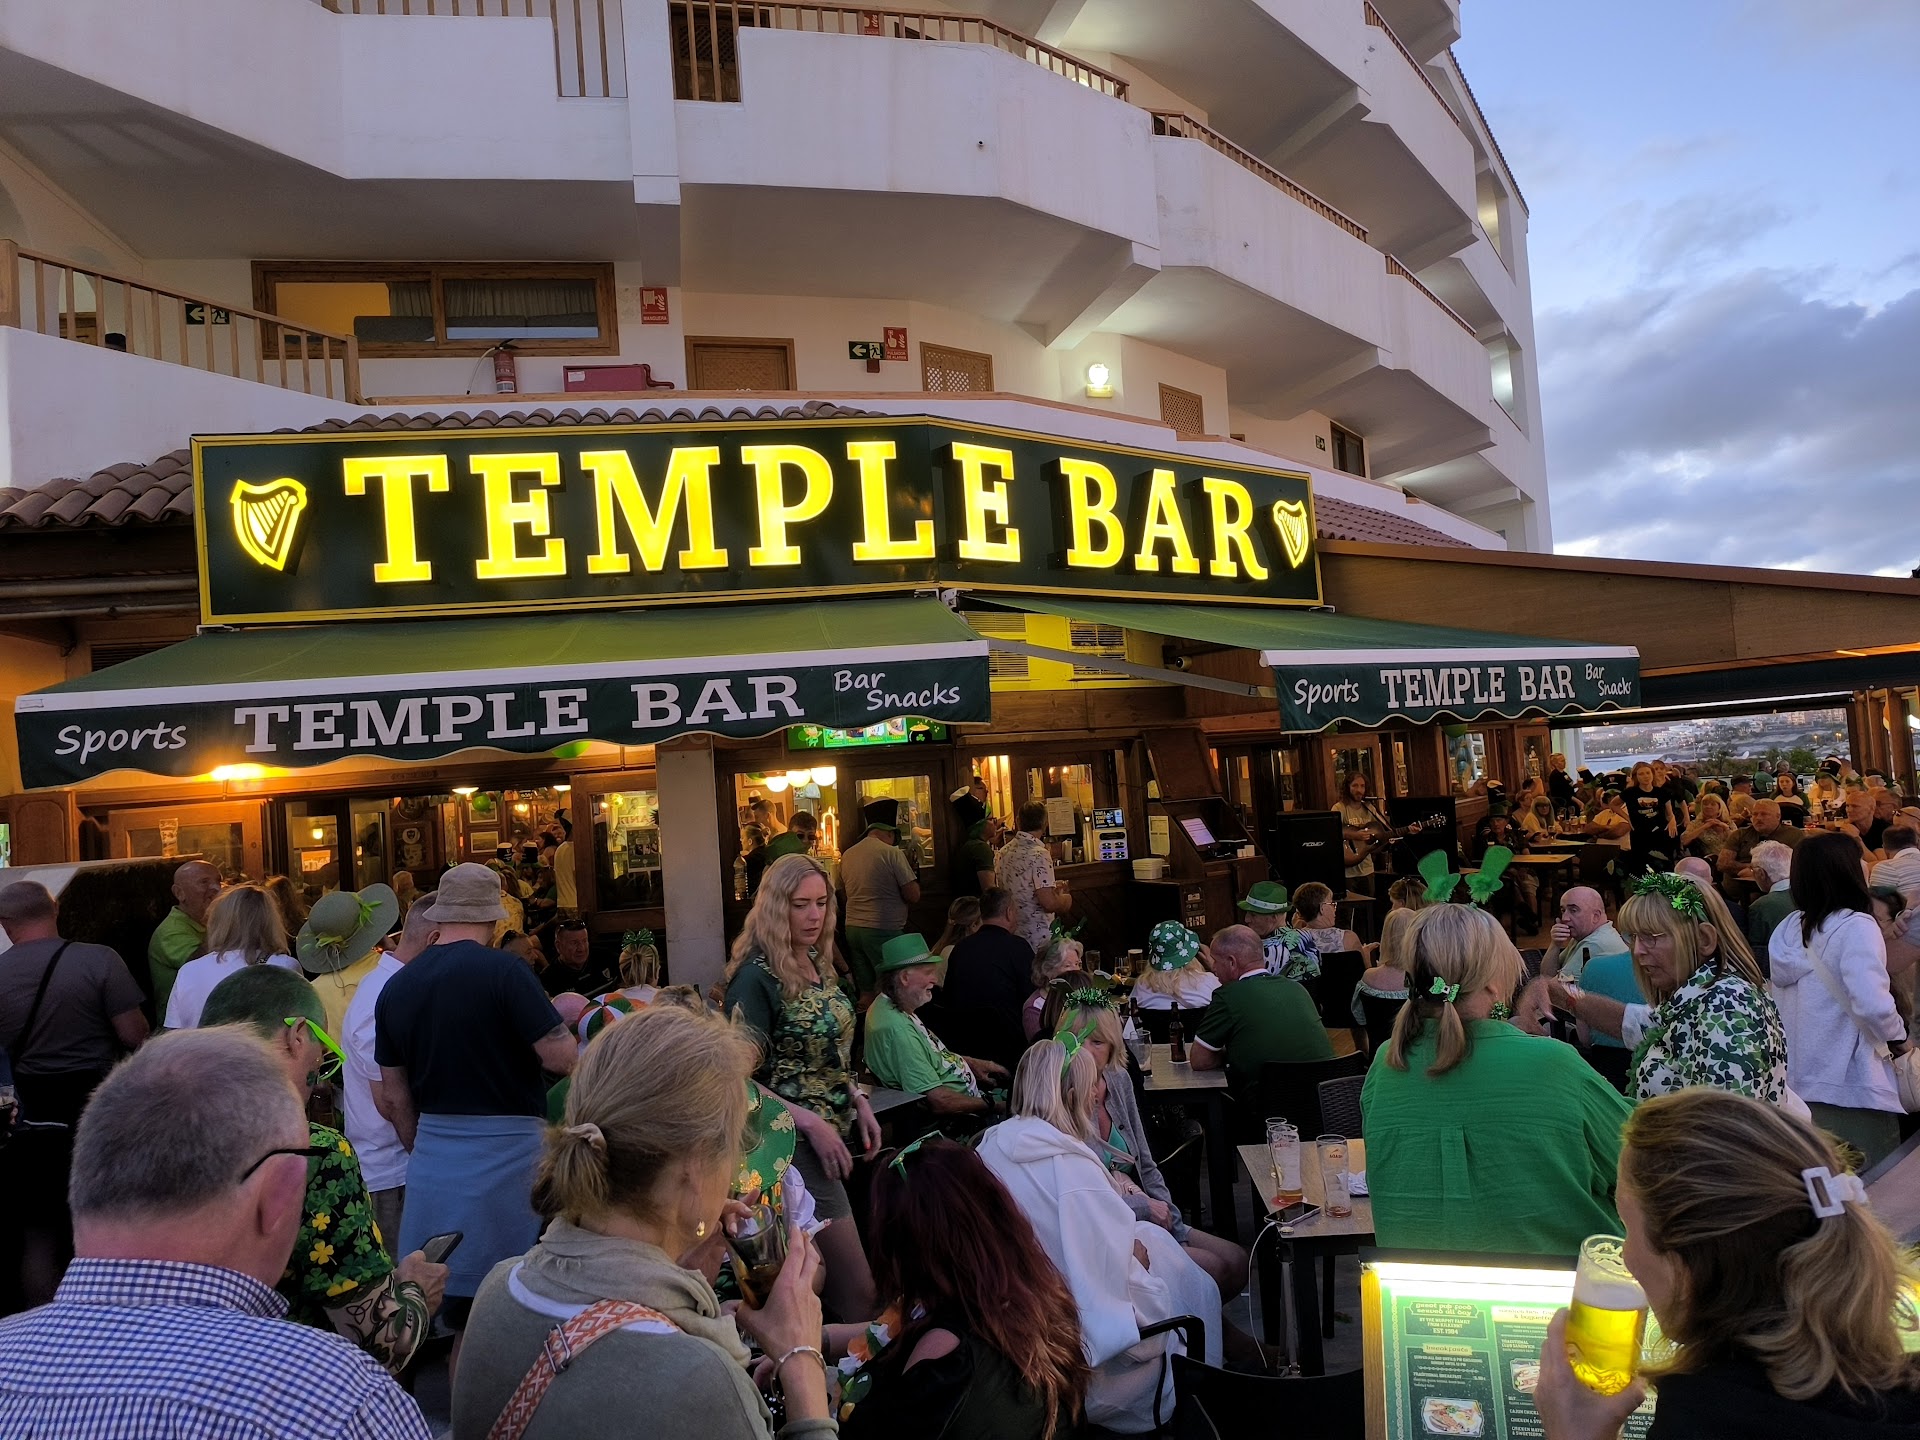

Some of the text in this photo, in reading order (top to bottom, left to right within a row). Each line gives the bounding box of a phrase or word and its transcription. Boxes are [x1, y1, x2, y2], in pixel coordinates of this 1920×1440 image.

[343, 441, 1269, 582] TEMPLE BAR
[55, 670, 886, 764] Sports TEMPLE BAR Bar
[866, 682, 960, 710] Snacks
[1293, 662, 1605, 714] Sports TEMPLE BAR Bar
